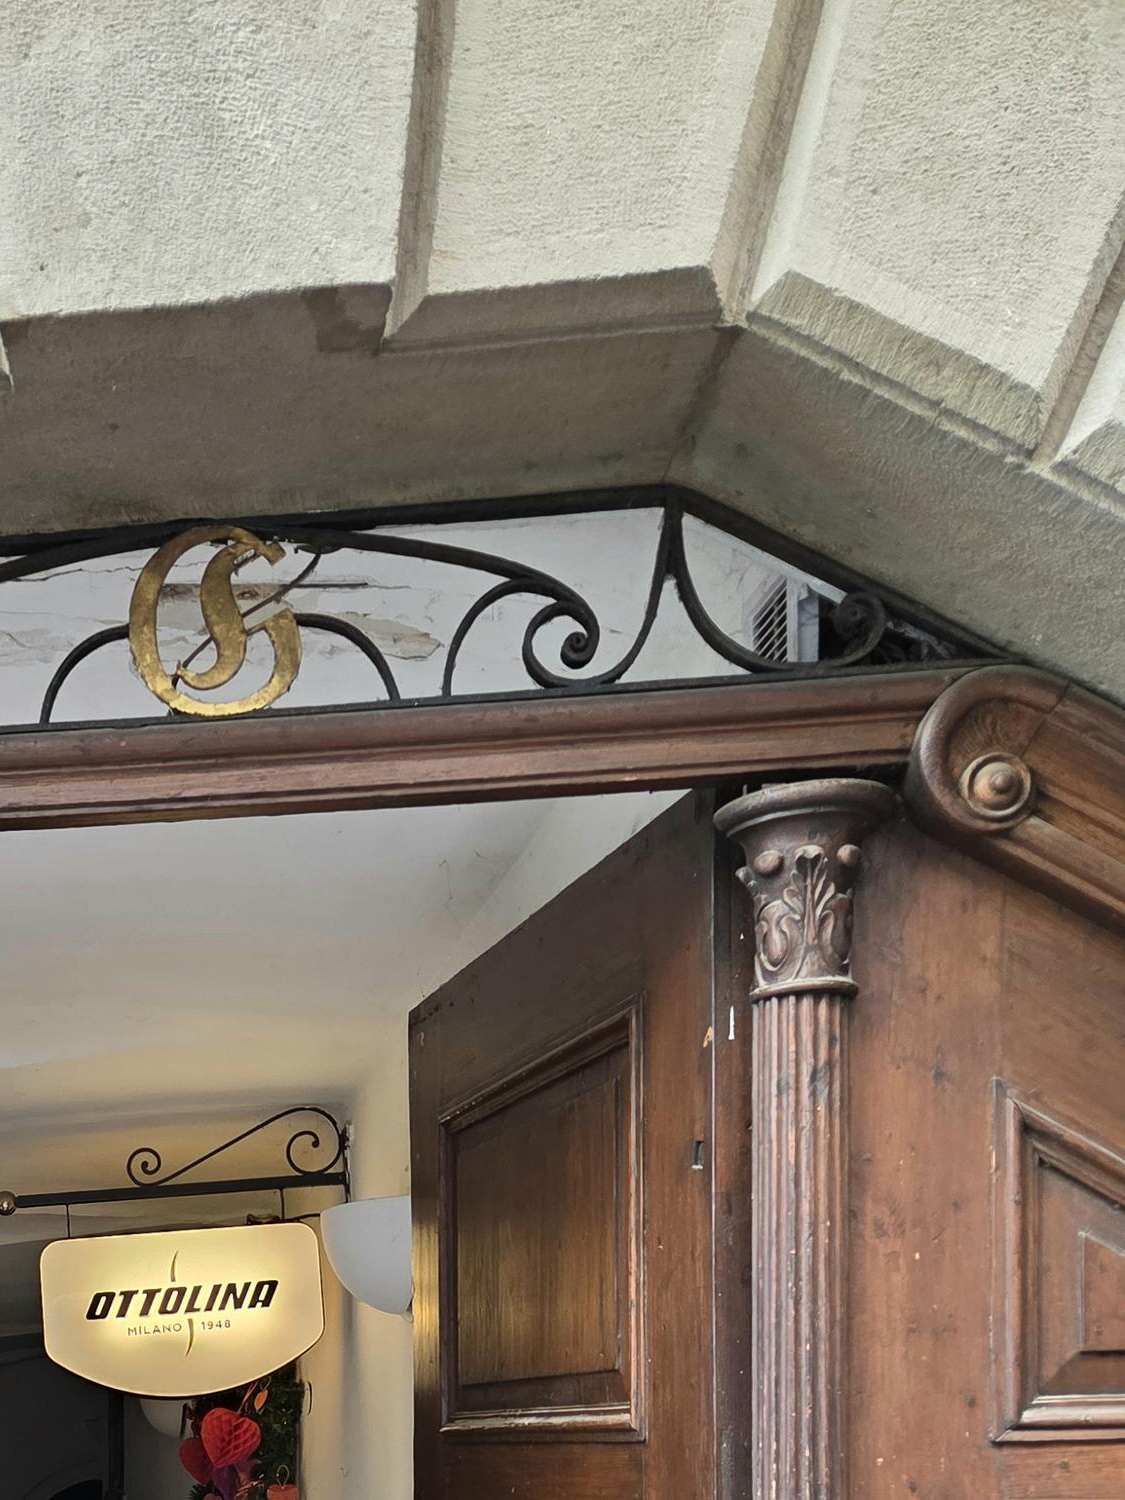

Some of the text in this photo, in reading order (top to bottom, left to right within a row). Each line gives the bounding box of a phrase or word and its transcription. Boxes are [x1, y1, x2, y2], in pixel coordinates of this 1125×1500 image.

[85, 1280, 279, 1320] OTTOLINA
[127, 1320, 231, 1336] MILANO 1948
